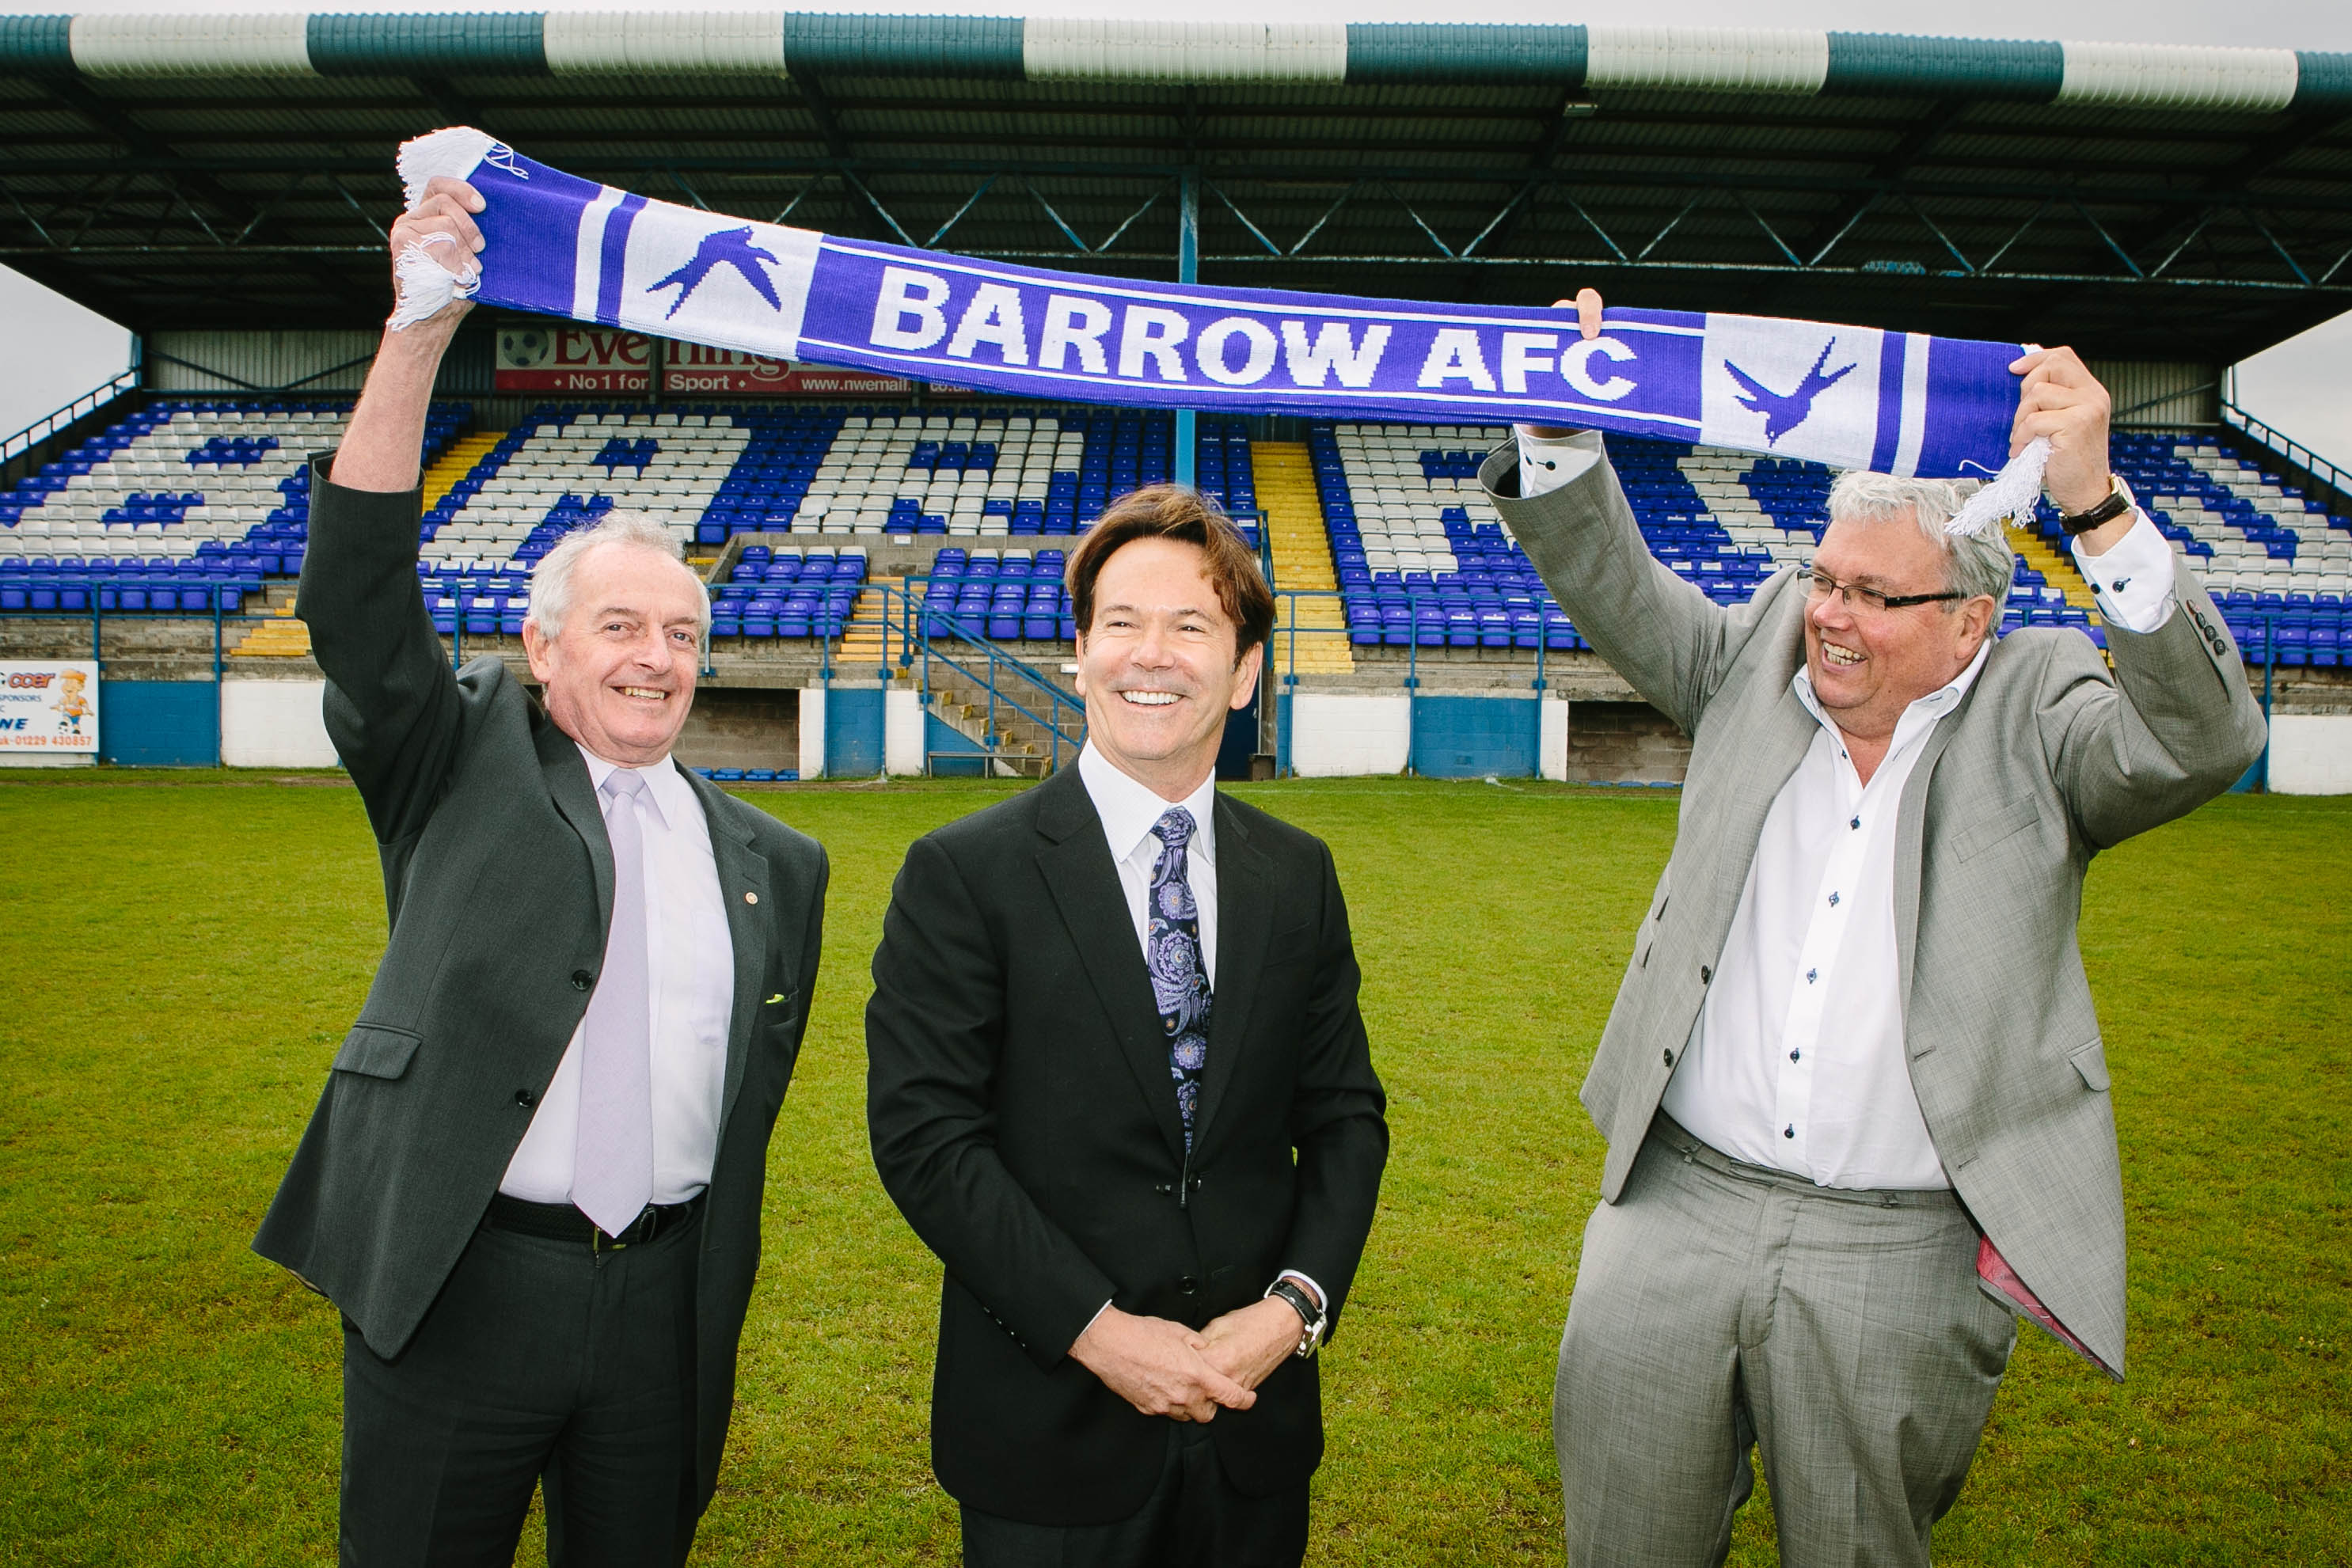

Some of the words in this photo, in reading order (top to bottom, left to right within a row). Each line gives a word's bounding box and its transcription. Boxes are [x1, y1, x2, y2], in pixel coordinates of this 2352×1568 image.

[870, 265, 1393, 388] BARROW
[1417, 328, 1637, 401] AFC
[569, 374, 598, 389] No
[602, 374, 611, 389] 1
[620, 374, 648, 389] for
[670, 374, 729, 391] Sport
[51, 735, 92, 746] 430857
